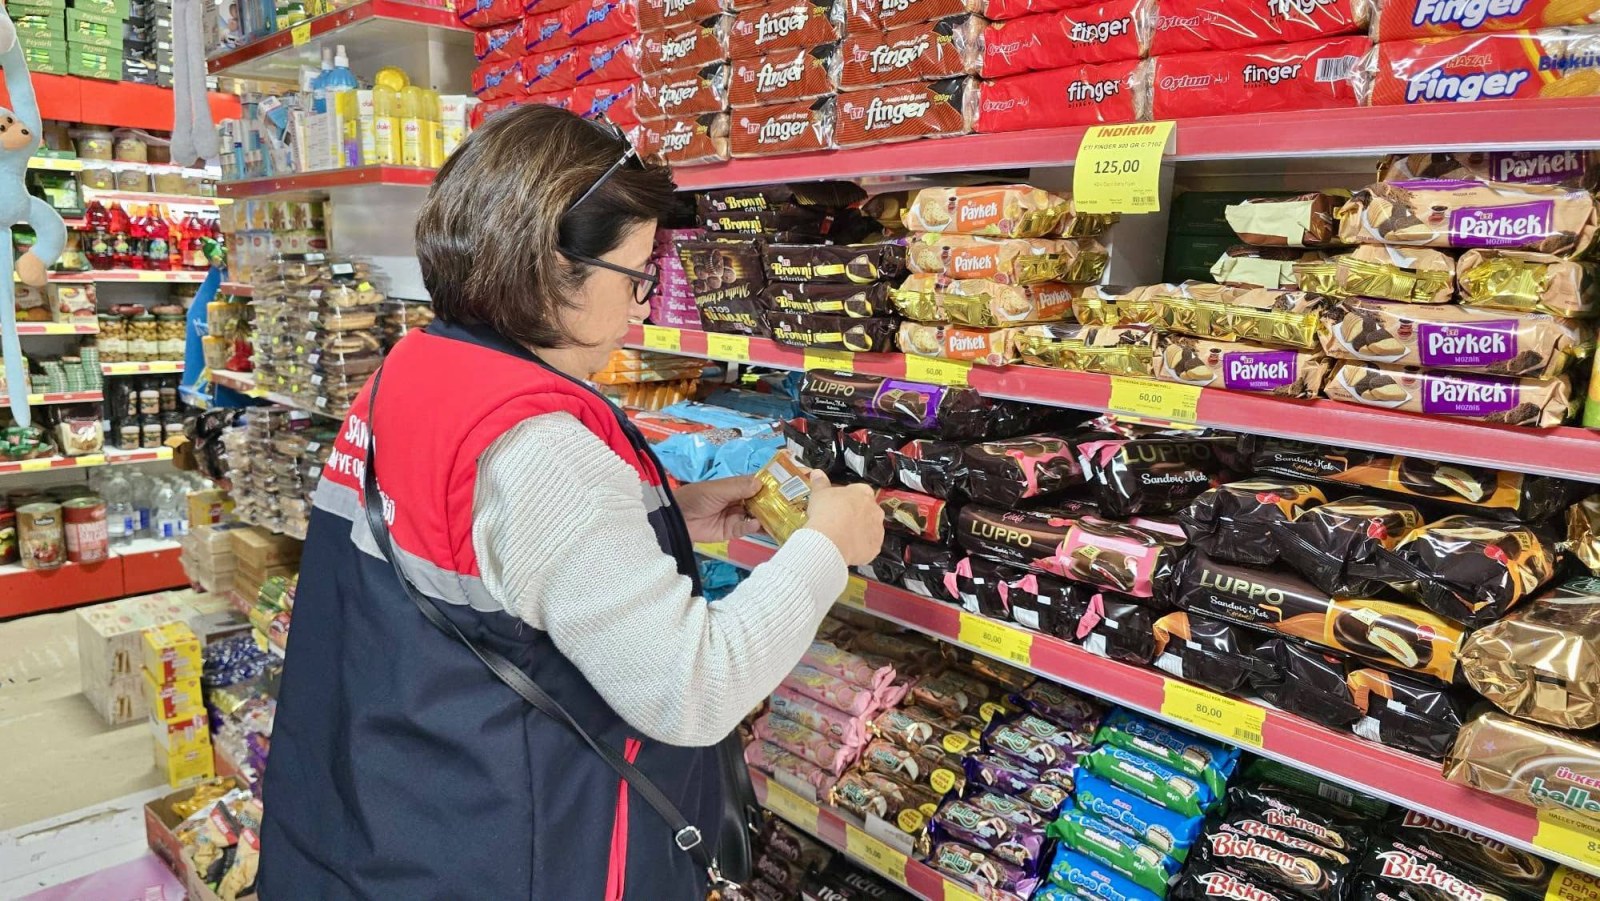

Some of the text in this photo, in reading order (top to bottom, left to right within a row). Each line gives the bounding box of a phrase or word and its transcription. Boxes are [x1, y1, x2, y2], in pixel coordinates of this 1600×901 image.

[1070, 18, 1131, 43] finger
[1446, 54, 1493, 68] HAZAL
[1161, 74, 1211, 92] Oylum
[1244, 63, 1302, 85] finger
[1406, 67, 1530, 102] Finger
[1068, 80, 1121, 104] finger
[864, 97, 930, 131] finger
[1097, 124, 1156, 138] İNDİRİM
[1094, 160, 1140, 175] 125,00
[1500, 151, 1578, 182] Paykek
[724, 192, 767, 210] Browni
[719, 216, 762, 233] Browni
[961, 205, 998, 222] Paykek
[1460, 214, 1542, 239] Paykek
[770, 262, 813, 279] Browni
[955, 256, 992, 273] Paykek
[776, 296, 814, 313] Browni
[1040, 288, 1072, 309] Paykek
[774, 327, 813, 345] Browni
[950, 336, 985, 353] Paykek
[1429, 331, 1506, 356] Paykek
[926, 368, 943, 376] 60,00
[1230, 360, 1289, 381] Paykek
[810, 379, 855, 397] LUPPO
[1139, 393, 1162, 404] 60,00
[1431, 379, 1507, 403] Paykek
[1122, 444, 1210, 465] LUPPO
[1274, 454, 1335, 471] Sandviç Kek
[1142, 471, 1208, 485] Sandviç Kek
[971, 520, 1032, 548] LUPPO
[1200, 570, 1285, 605] LUPPO
[1210, 595, 1270, 620] Sandviç Kek
[983, 632, 1002, 644] 80,00
[1196, 704, 1223, 719] 80,00
[996, 726, 1032, 753] halley
[1556, 766, 1600, 789] ÜLKER
[946, 802, 982, 829] halley
[1092, 798, 1147, 836] Coco Star
[1262, 808, 1327, 838] Biskrem
[1234, 819, 1326, 856] Biskrem
[940, 846, 973, 875] halley
[1208, 832, 1297, 870] Biskrem
[1068, 868, 1098, 891] Coco
[1376, 850, 1484, 901] Biskrem
[1562, 877, 1598, 899] Daha
